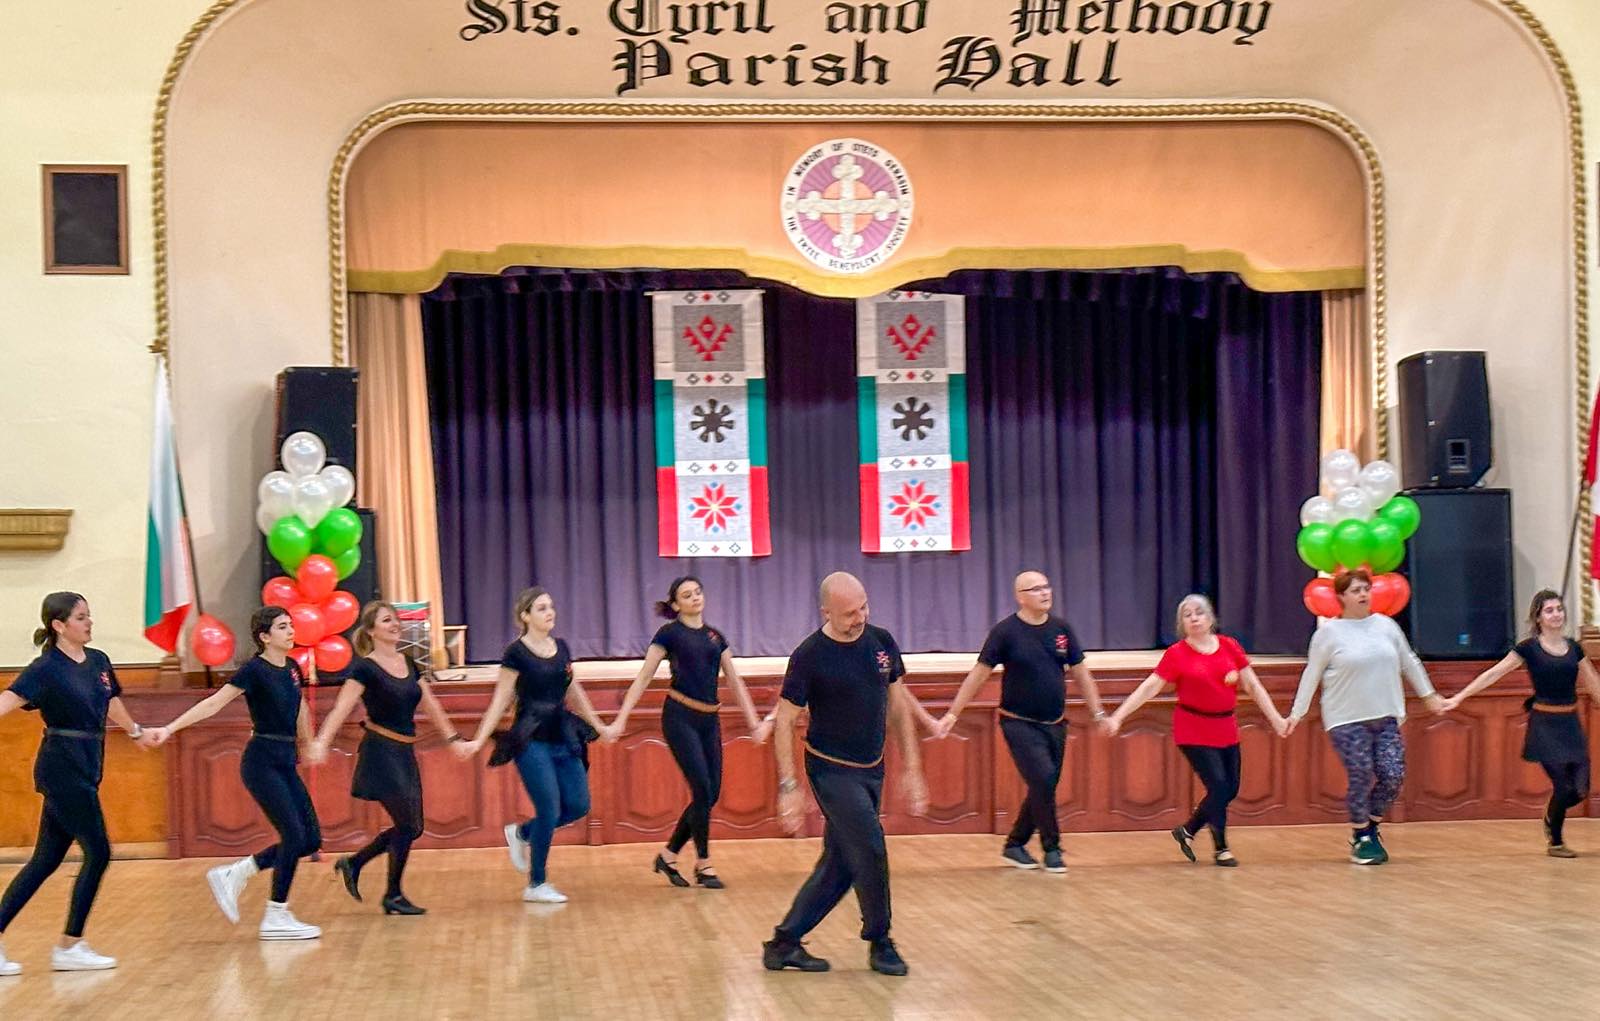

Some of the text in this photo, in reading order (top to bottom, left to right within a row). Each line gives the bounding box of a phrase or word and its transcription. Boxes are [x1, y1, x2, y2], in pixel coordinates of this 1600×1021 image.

[460, 0, 1273, 47] Sts. Cyril and Methody
[612, 35, 1121, 96] Parish Hall
[786, 185, 796, 196] IN
[793, 148, 823, 177] MEMORY
[831, 142, 844, 152] OF
[785, 216, 798, 232] THE
[829, 252, 881, 271] BENEVOLENT
